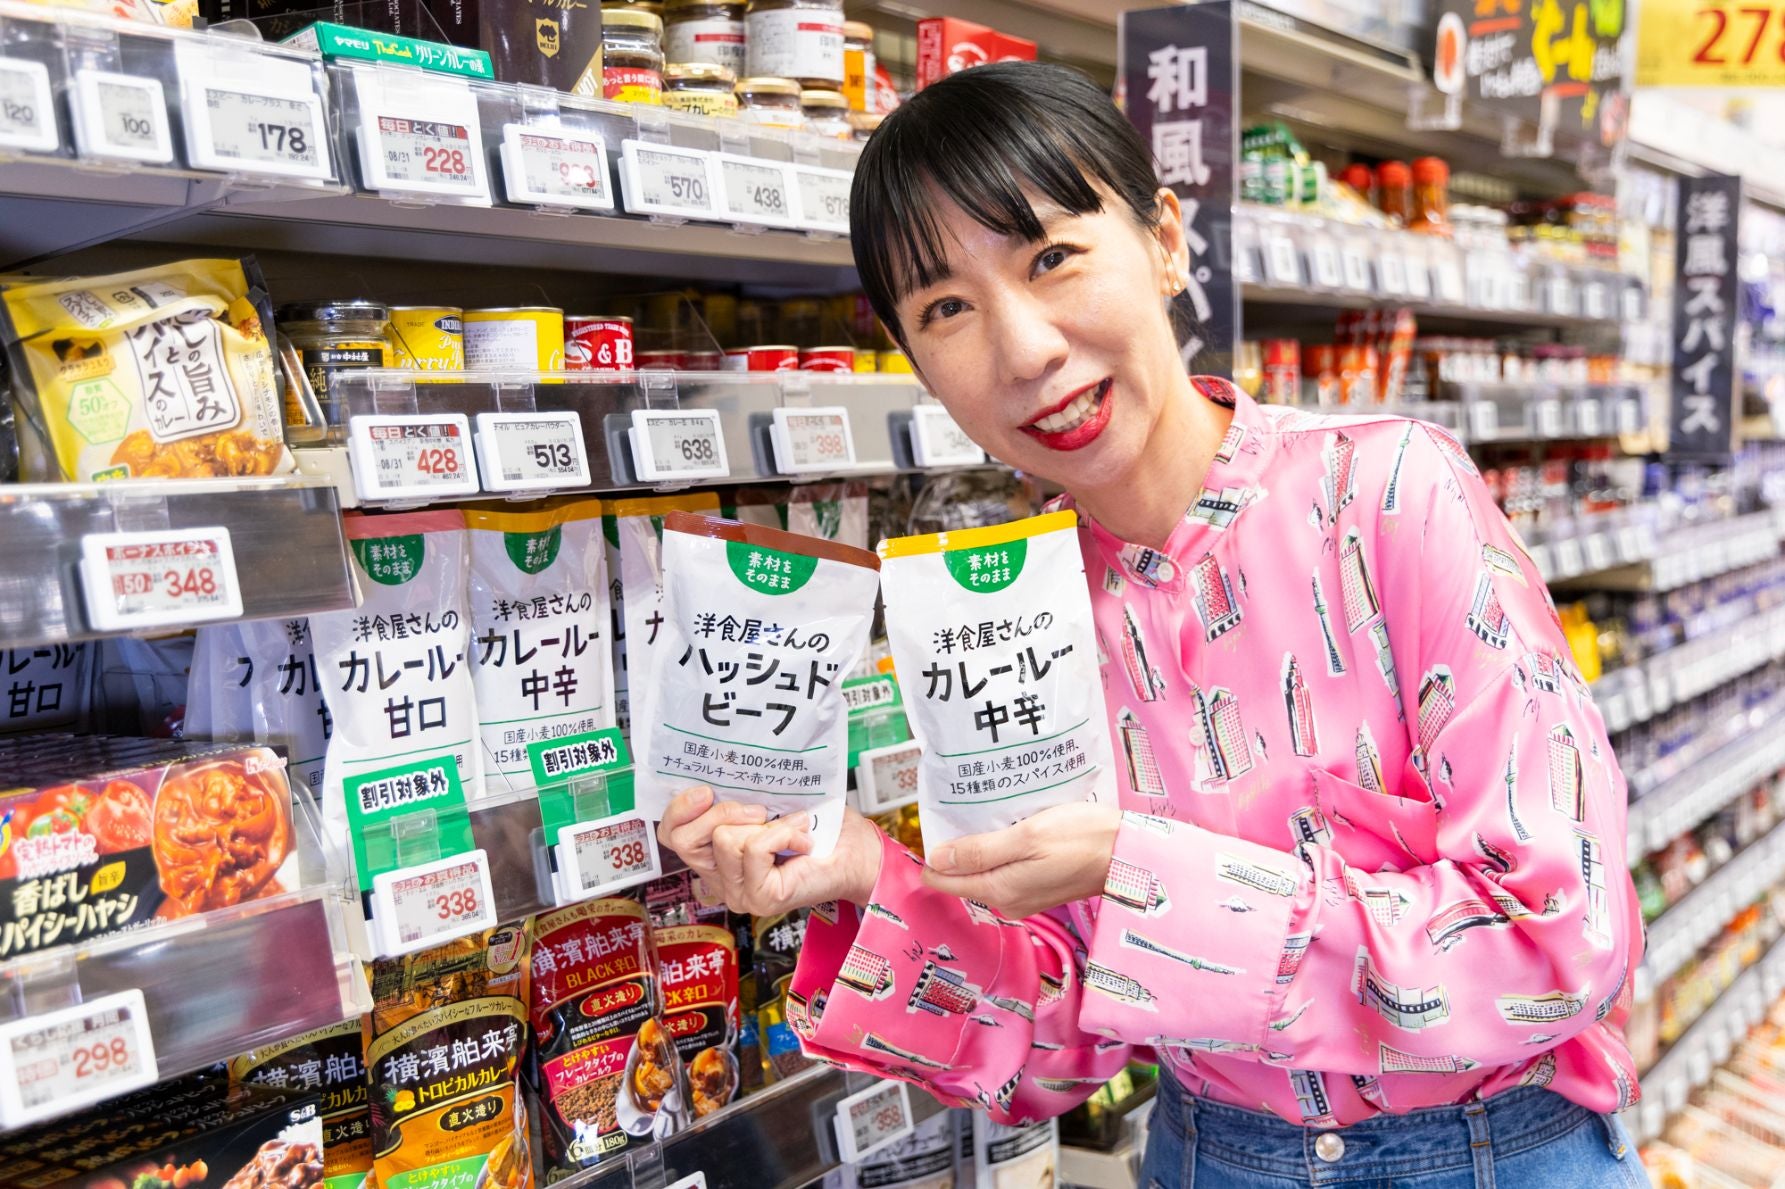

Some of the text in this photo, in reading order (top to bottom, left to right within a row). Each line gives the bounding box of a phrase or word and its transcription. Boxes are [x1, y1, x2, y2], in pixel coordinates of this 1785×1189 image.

[1692, 8, 1785, 64] 27
[416, 44, 486, 74] グリーンカレーの素
[122, 116, 151, 135] 100
[258, 122, 307, 153] 178
[424, 146, 466, 174] 228
[671, 175, 703, 200] 570
[754, 186, 781, 208] 438
[1681, 190, 1730, 434] 洋風スパイス
[533, 443, 572, 468] 513
[682, 438, 713, 460] 638
[816, 434, 843, 455] 398
[417, 448, 459, 474] 428
[369, 544, 406, 560] 素材を
[748, 551, 792, 574] 素材を
[968, 551, 1009, 571] 素材を
[164, 567, 216, 597] 348
[372, 561, 412, 577] そのまま
[745, 568, 791, 589] そのまま
[969, 568, 1011, 587] そのまま
[492, 592, 592, 622] 洋食屋さんの
[352, 609, 459, 644] 洋食屋さんの
[693, 613, 830, 653] 洋食屋さんの
[933, 611, 1054, 655] 洋食屋さんの
[678, 644, 839, 700] ハッシュド
[922, 645, 1074, 702] カレールー
[8, 680, 63, 718] 甘口
[521, 665, 579, 711] 中辛
[384, 695, 447, 739] 甘口
[702, 692, 797, 736] ビーフ
[973, 691, 1046, 743] 中辛
[543, 738, 616, 774] 割引対象外
[662, 754, 821, 786] ナチュラルチーズ・赤ワイン使用
[683, 741, 809, 772] 国産小麦100%使用、
[957, 738, 1080, 778] 国産小麦100%使用、
[951, 752, 1087, 795] 15種類のスパイス使用
[361, 769, 447, 810] 割引対象外
[610, 841, 645, 869] 338
[12, 871, 89, 918] 香ばし
[436, 887, 477, 919] 338
[0, 892, 139, 957] パイシーハヤシ
[531, 920, 645, 978] 横濱舶来亭
[591, 986, 636, 1012] 直火造り
[73, 1036, 128, 1078] 298
[384, 1022, 519, 1085] 横濱舶来亭
[555, 1051, 625, 1080] フレークタイプの
[563, 1044, 610, 1068] とけやすい
[250, 1051, 368, 1092] 横濱舶
[418, 1065, 510, 1104] トロピカルカレー
[575, 1065, 612, 1084] カレールウ
[448, 1100, 498, 1128] 直火造り
[604, 1134, 626, 1149] 180g
[407, 1163, 461, 1184] とけやすい
